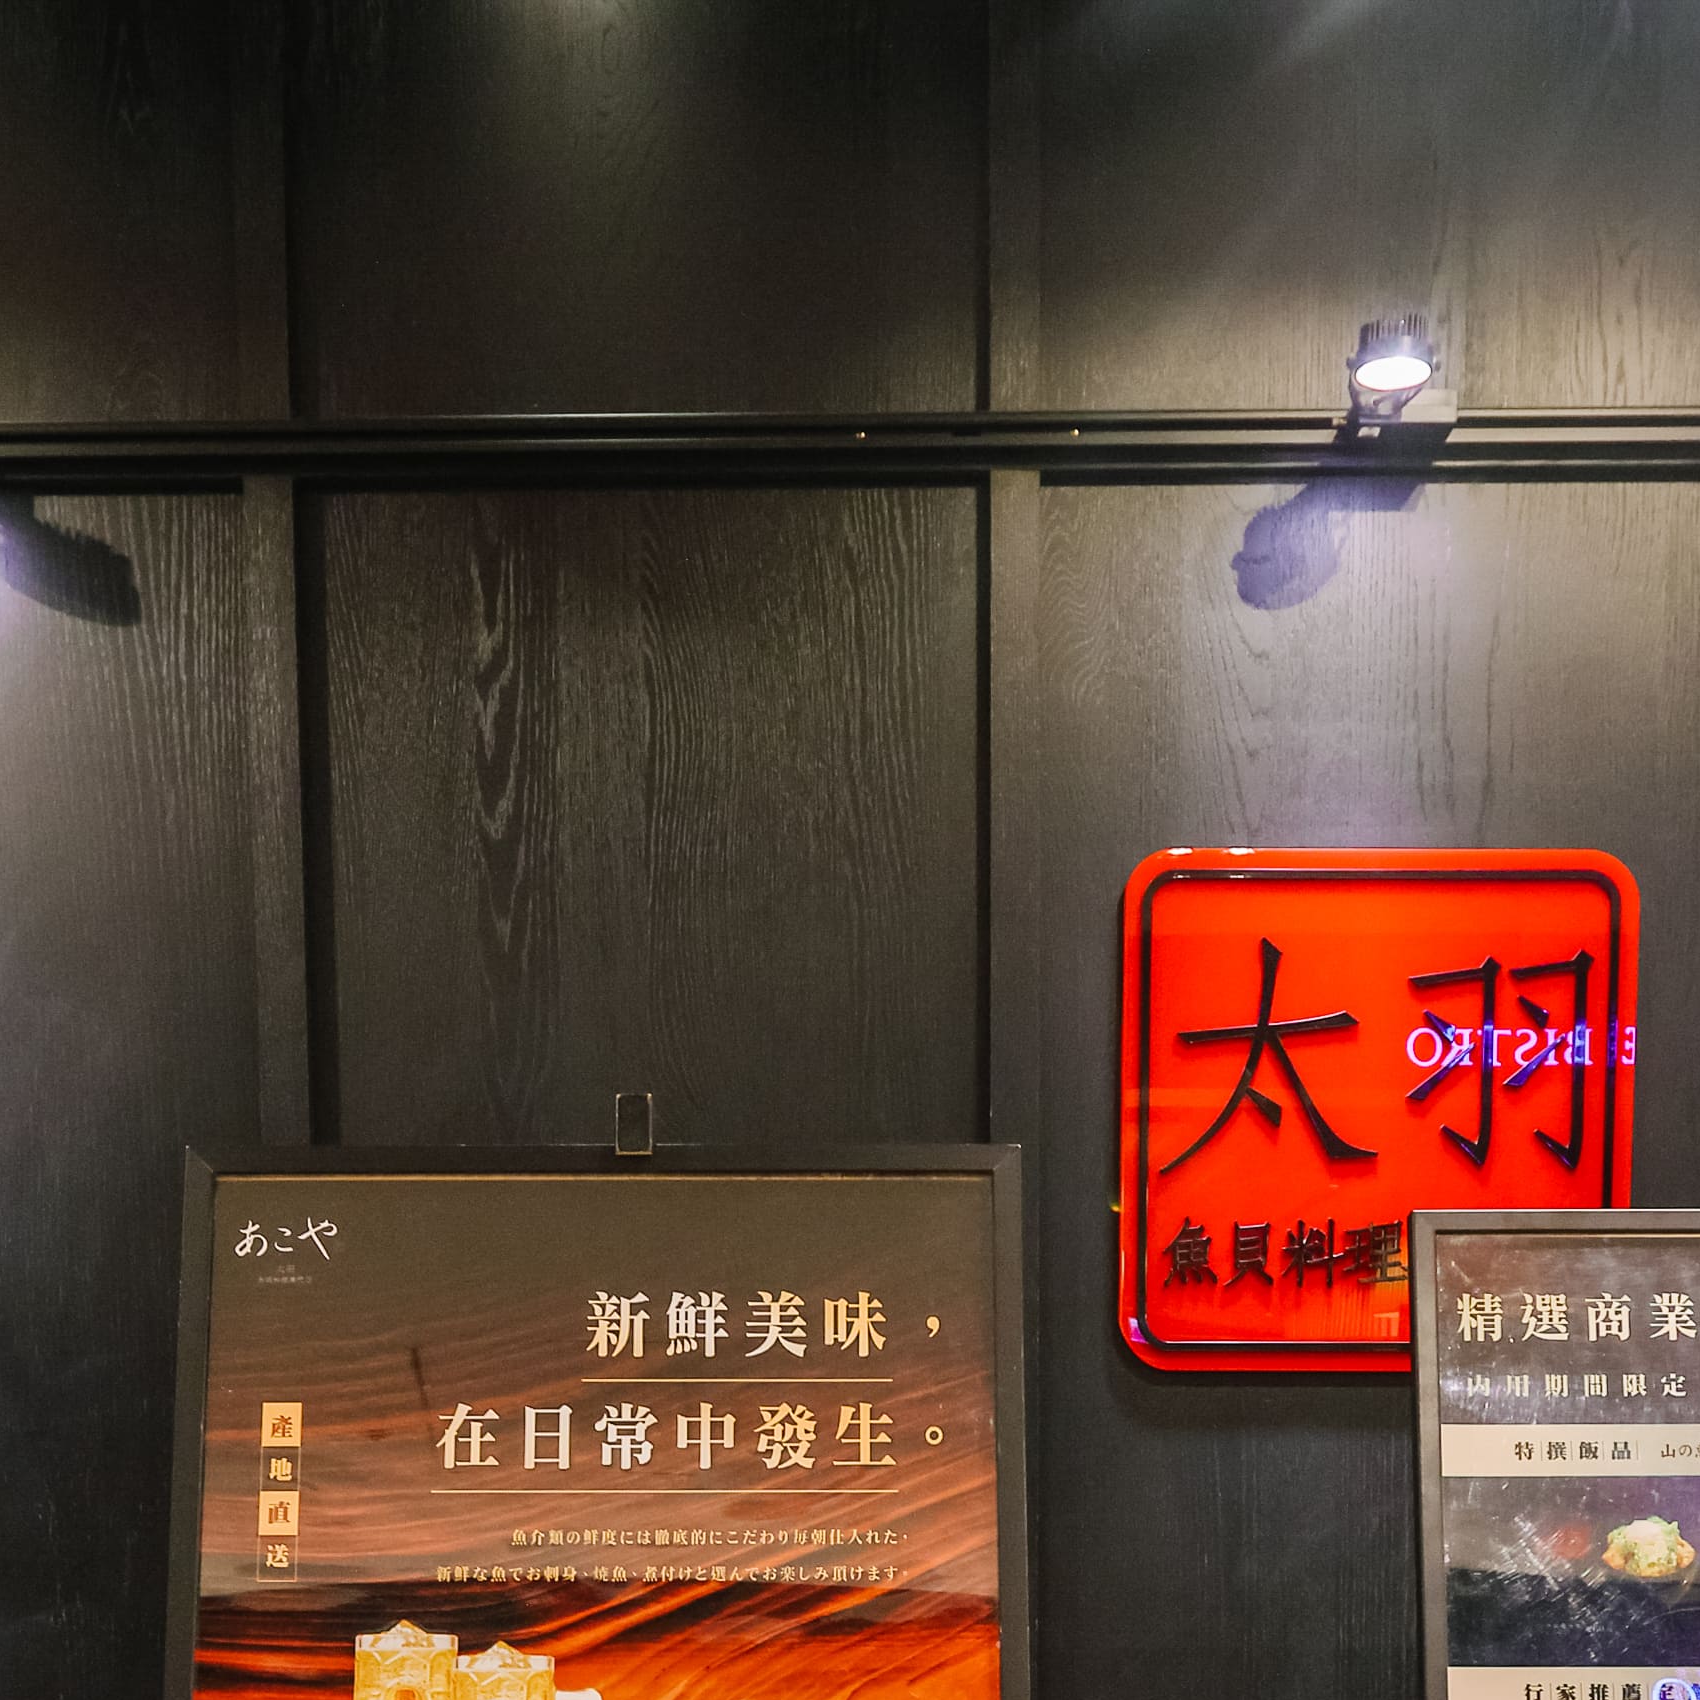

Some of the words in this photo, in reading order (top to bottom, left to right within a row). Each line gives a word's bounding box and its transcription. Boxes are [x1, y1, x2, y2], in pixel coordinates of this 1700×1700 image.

[1160, 937, 1596, 1175] 太羽
[234, 1216, 338, 1260] あこや
